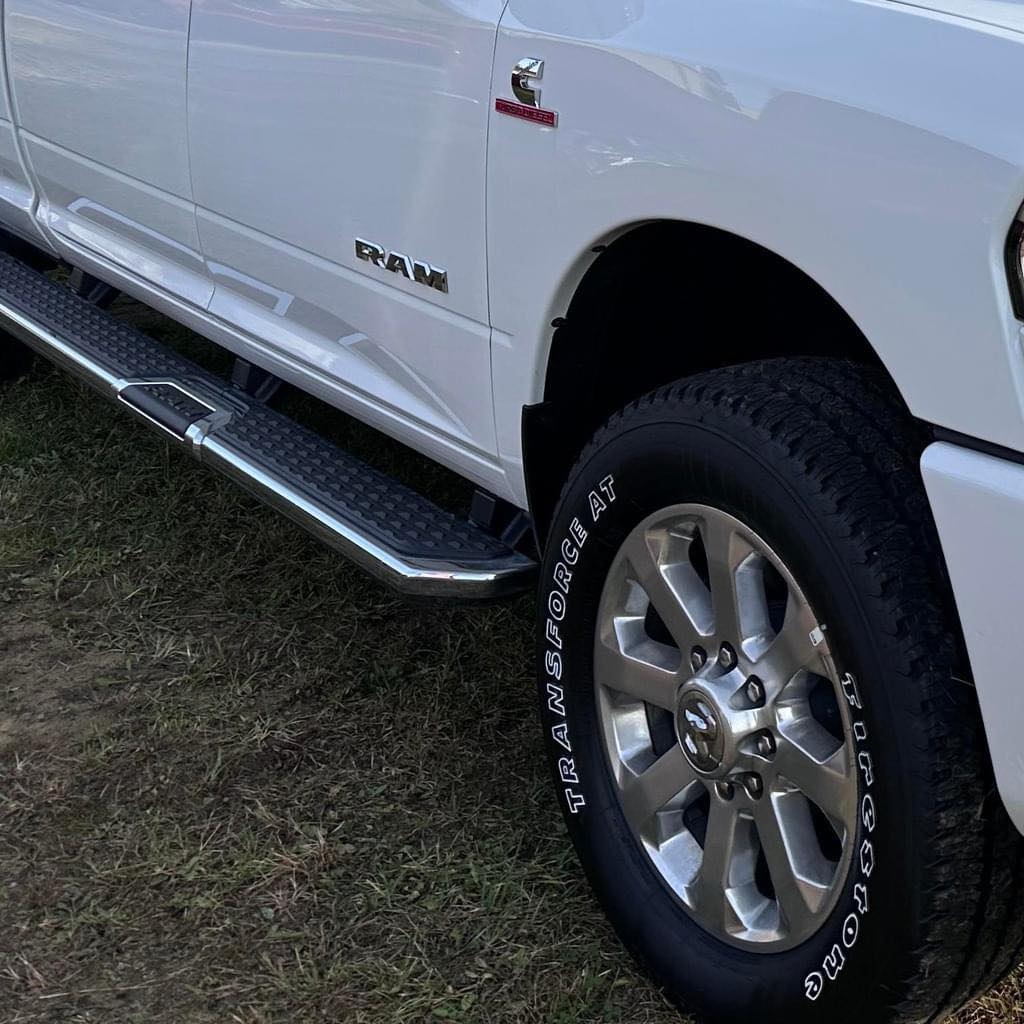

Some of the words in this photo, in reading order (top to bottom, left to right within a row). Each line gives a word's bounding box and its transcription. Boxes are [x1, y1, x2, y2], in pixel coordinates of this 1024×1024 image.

[355, 237, 449, 294] RAM
[545, 517, 588, 814] TRANSFORCE
[588, 474, 616, 522] AT
[804, 673, 876, 1001] Firestone
